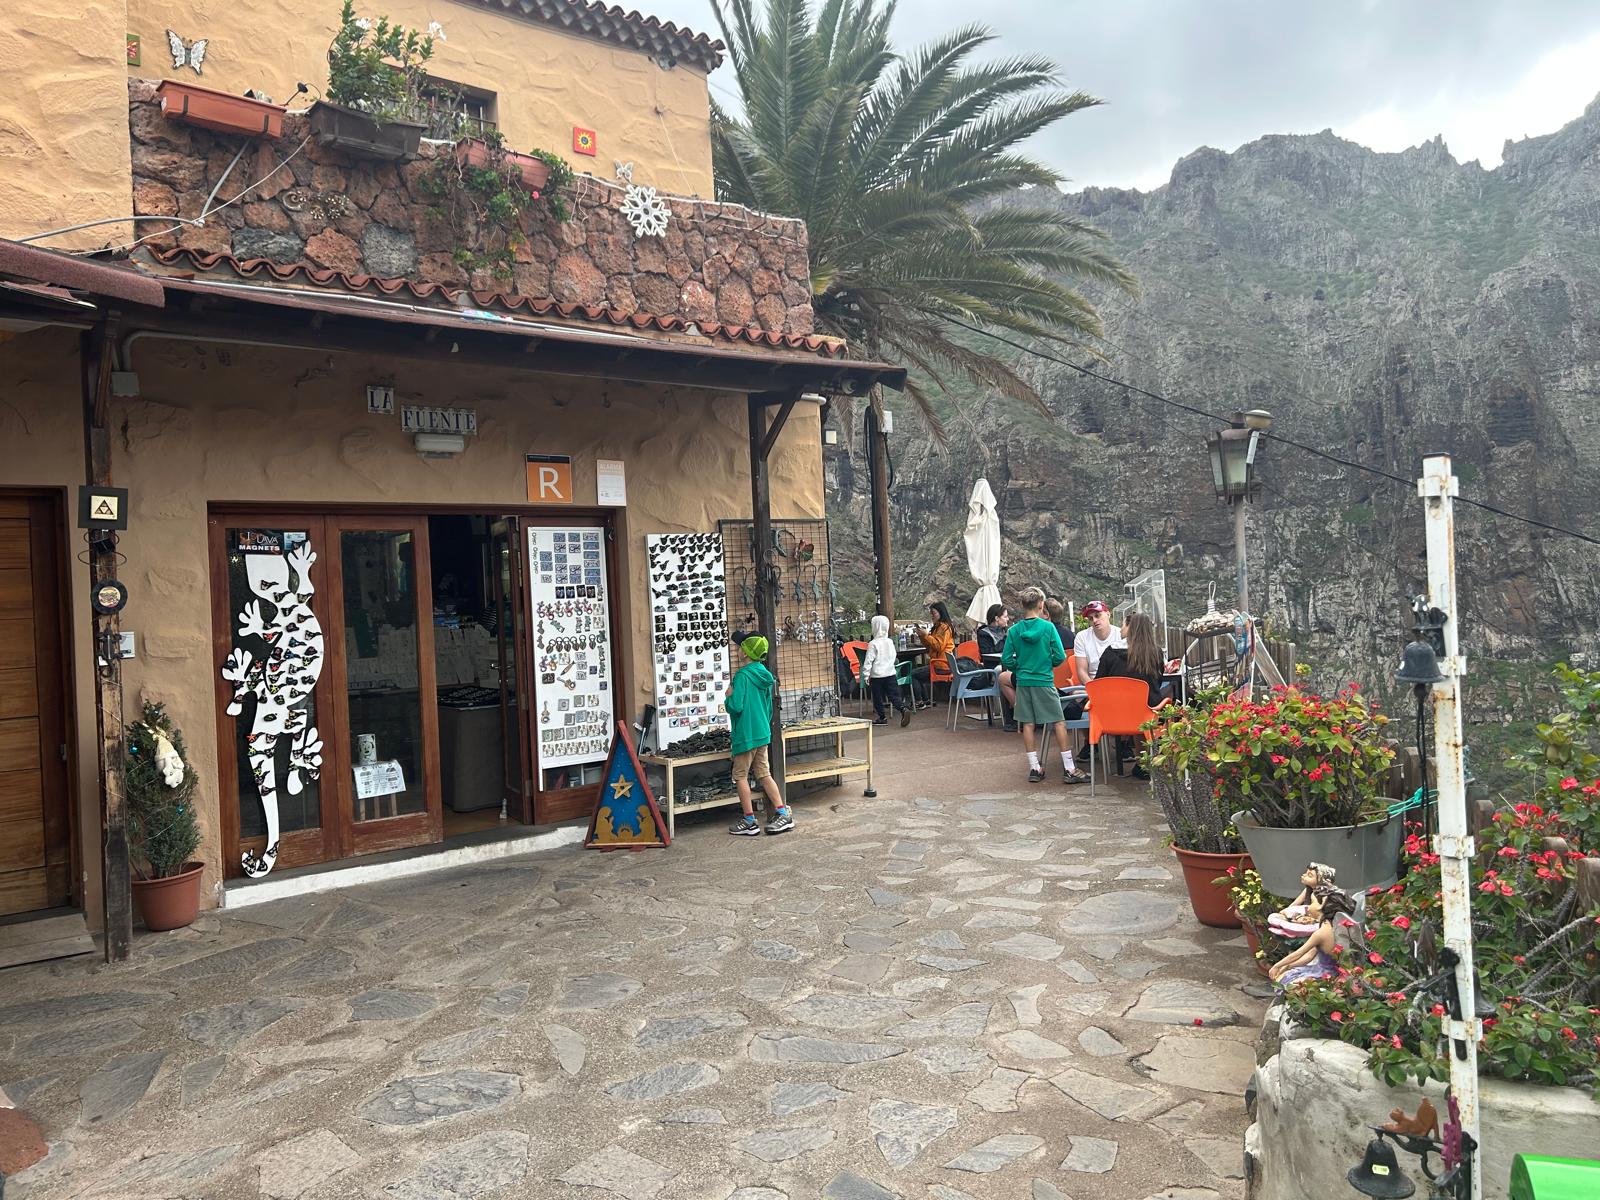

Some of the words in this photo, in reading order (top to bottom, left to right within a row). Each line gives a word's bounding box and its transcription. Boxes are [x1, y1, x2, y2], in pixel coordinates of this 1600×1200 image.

[369, 390, 393, 409] LA
[403, 410, 476, 430] FUENTE
[539, 467, 564, 498] R
